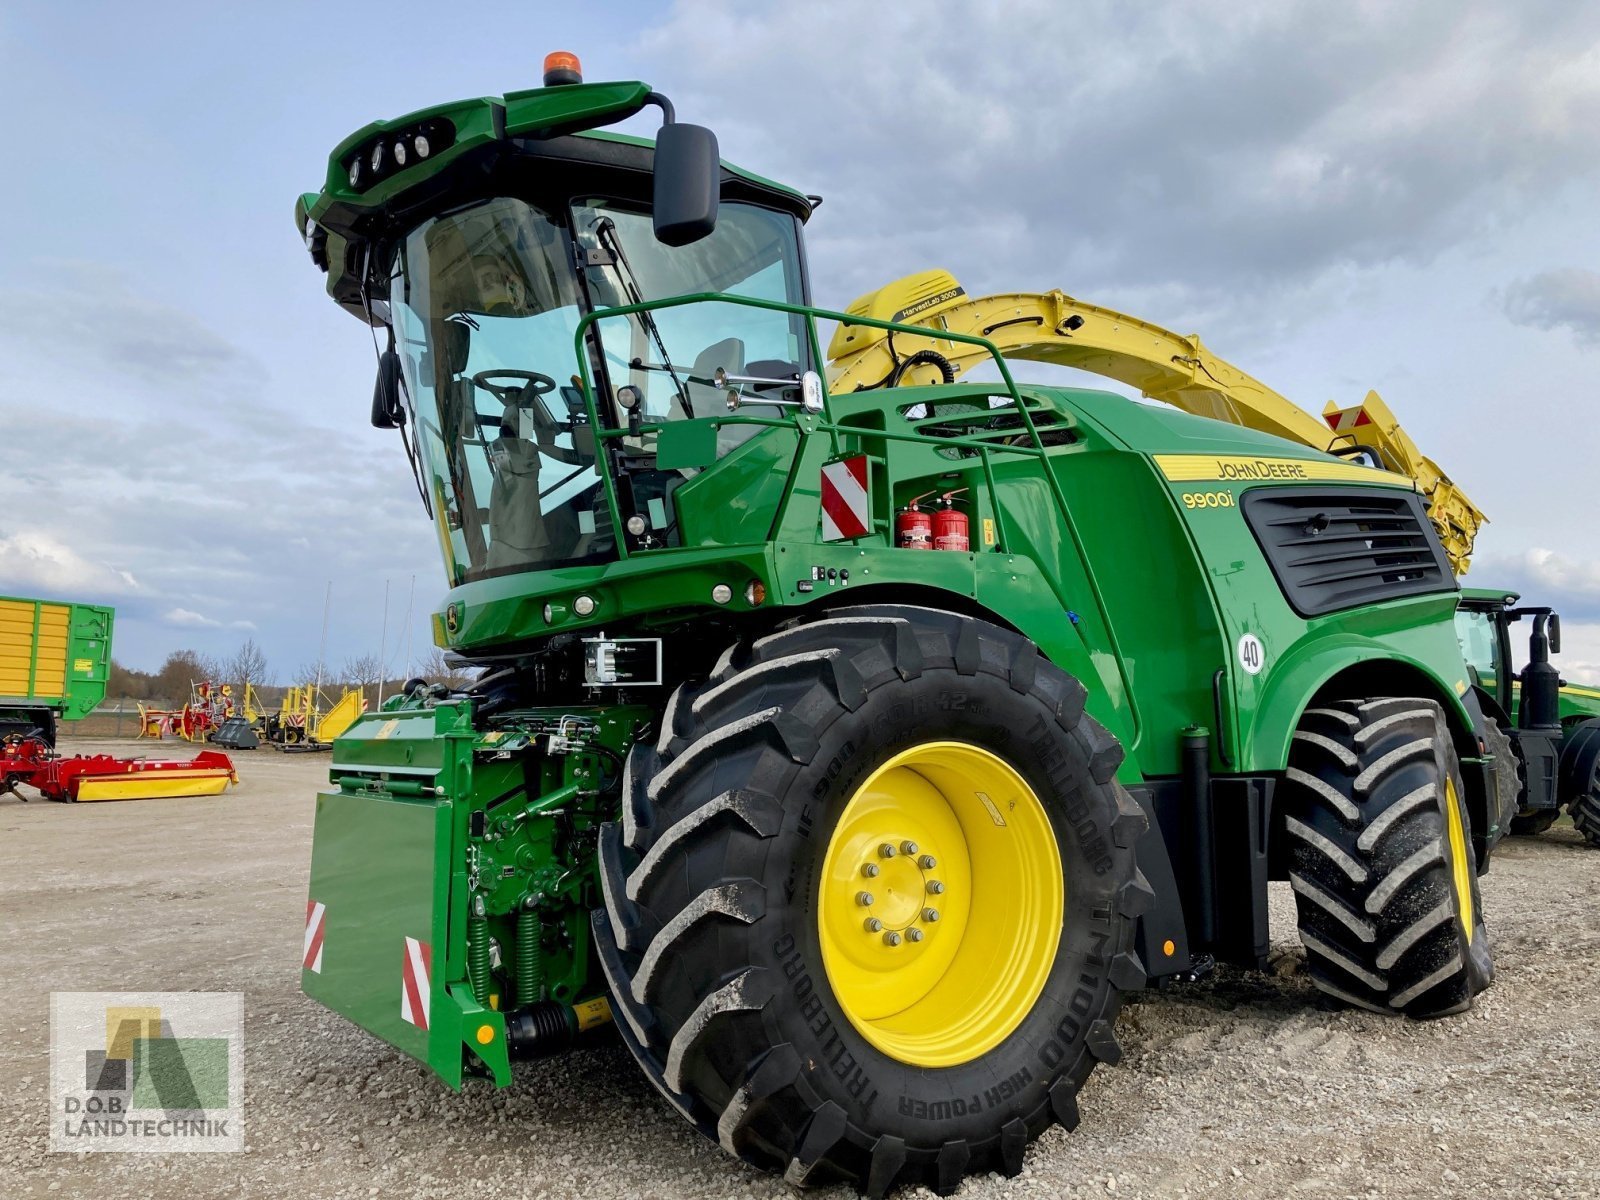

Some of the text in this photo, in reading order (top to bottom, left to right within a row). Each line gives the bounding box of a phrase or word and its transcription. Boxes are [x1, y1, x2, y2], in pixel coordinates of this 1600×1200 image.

[902, 290, 957, 317] HarvestLab 3000
[1182, 489, 1235, 509] 9900i
[1243, 640, 1259, 668] 40
[934, 688, 968, 711] 42
[1026, 712, 1114, 876] TRELLEBORG
[1037, 898, 1113, 1071] TM1000
[772, 931, 879, 1115] TRELLEBORG
[896, 1066, 1035, 1121] HIGH POWER
